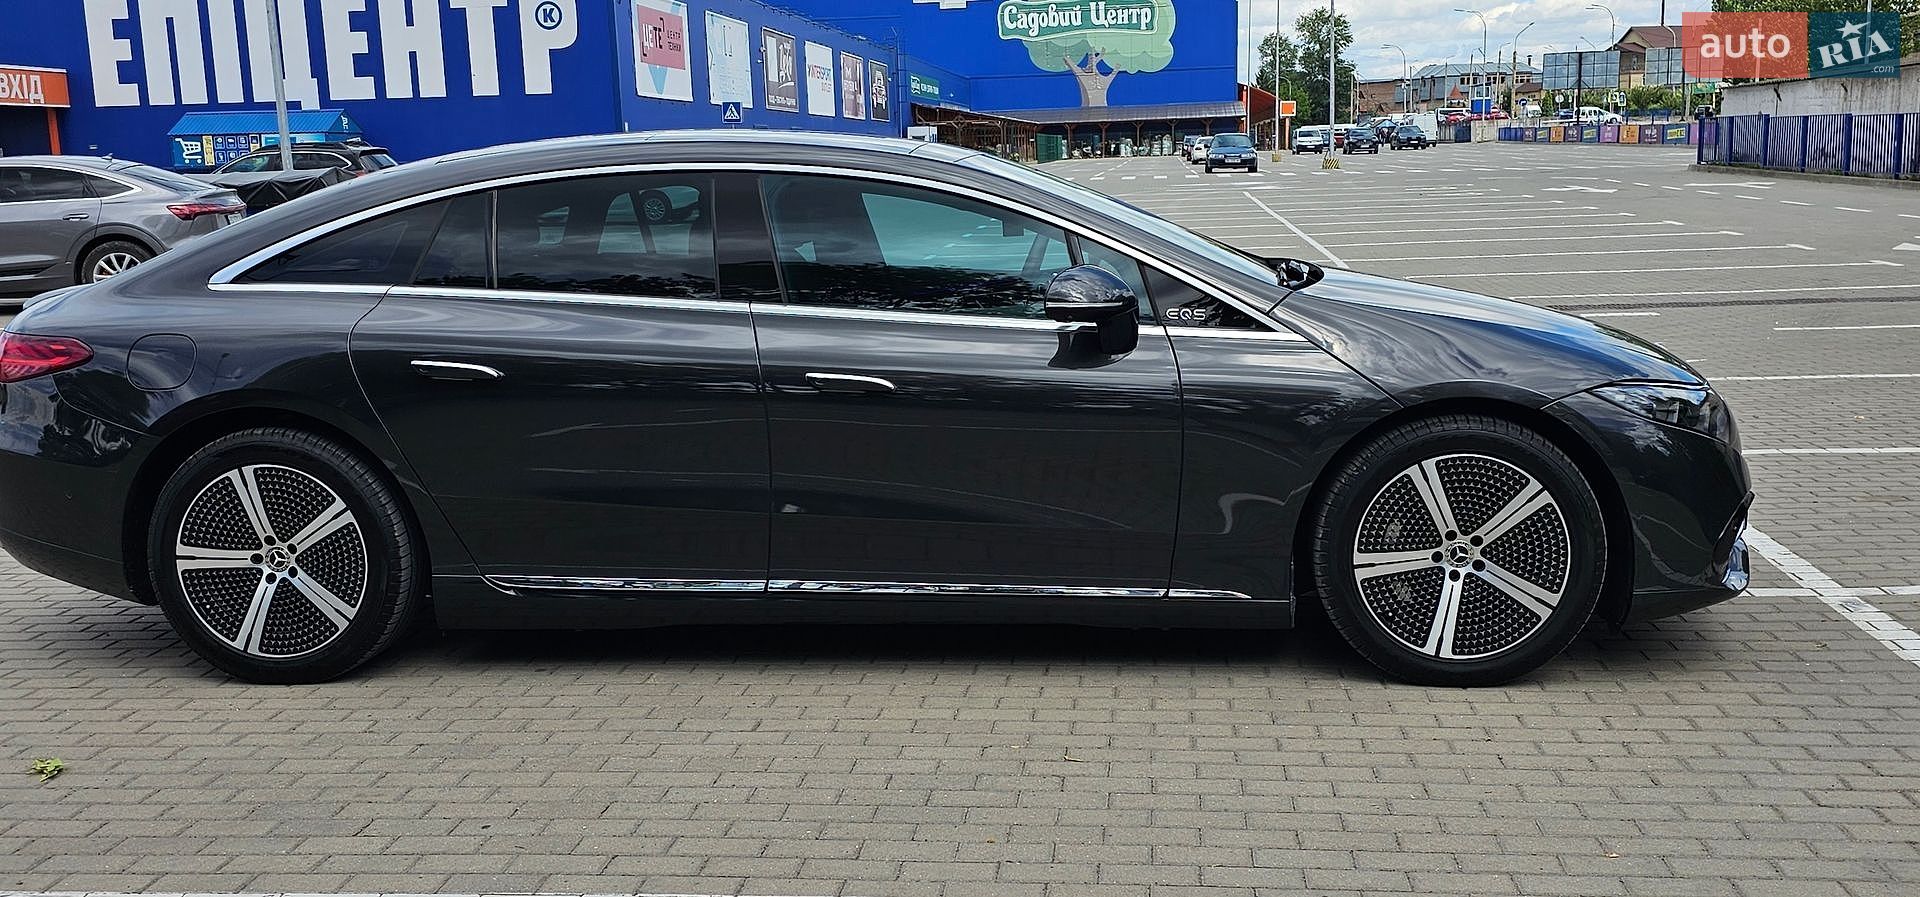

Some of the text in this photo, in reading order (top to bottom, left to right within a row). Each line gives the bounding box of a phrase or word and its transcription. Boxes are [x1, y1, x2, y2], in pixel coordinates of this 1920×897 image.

[1003, 1, 1152, 37] Садовий Центр
[84, 0, 578, 109] ЕПІЦЕНТР
[0, 73, 45, 104] ВХІД
[1166, 307, 1206, 320] EQS
